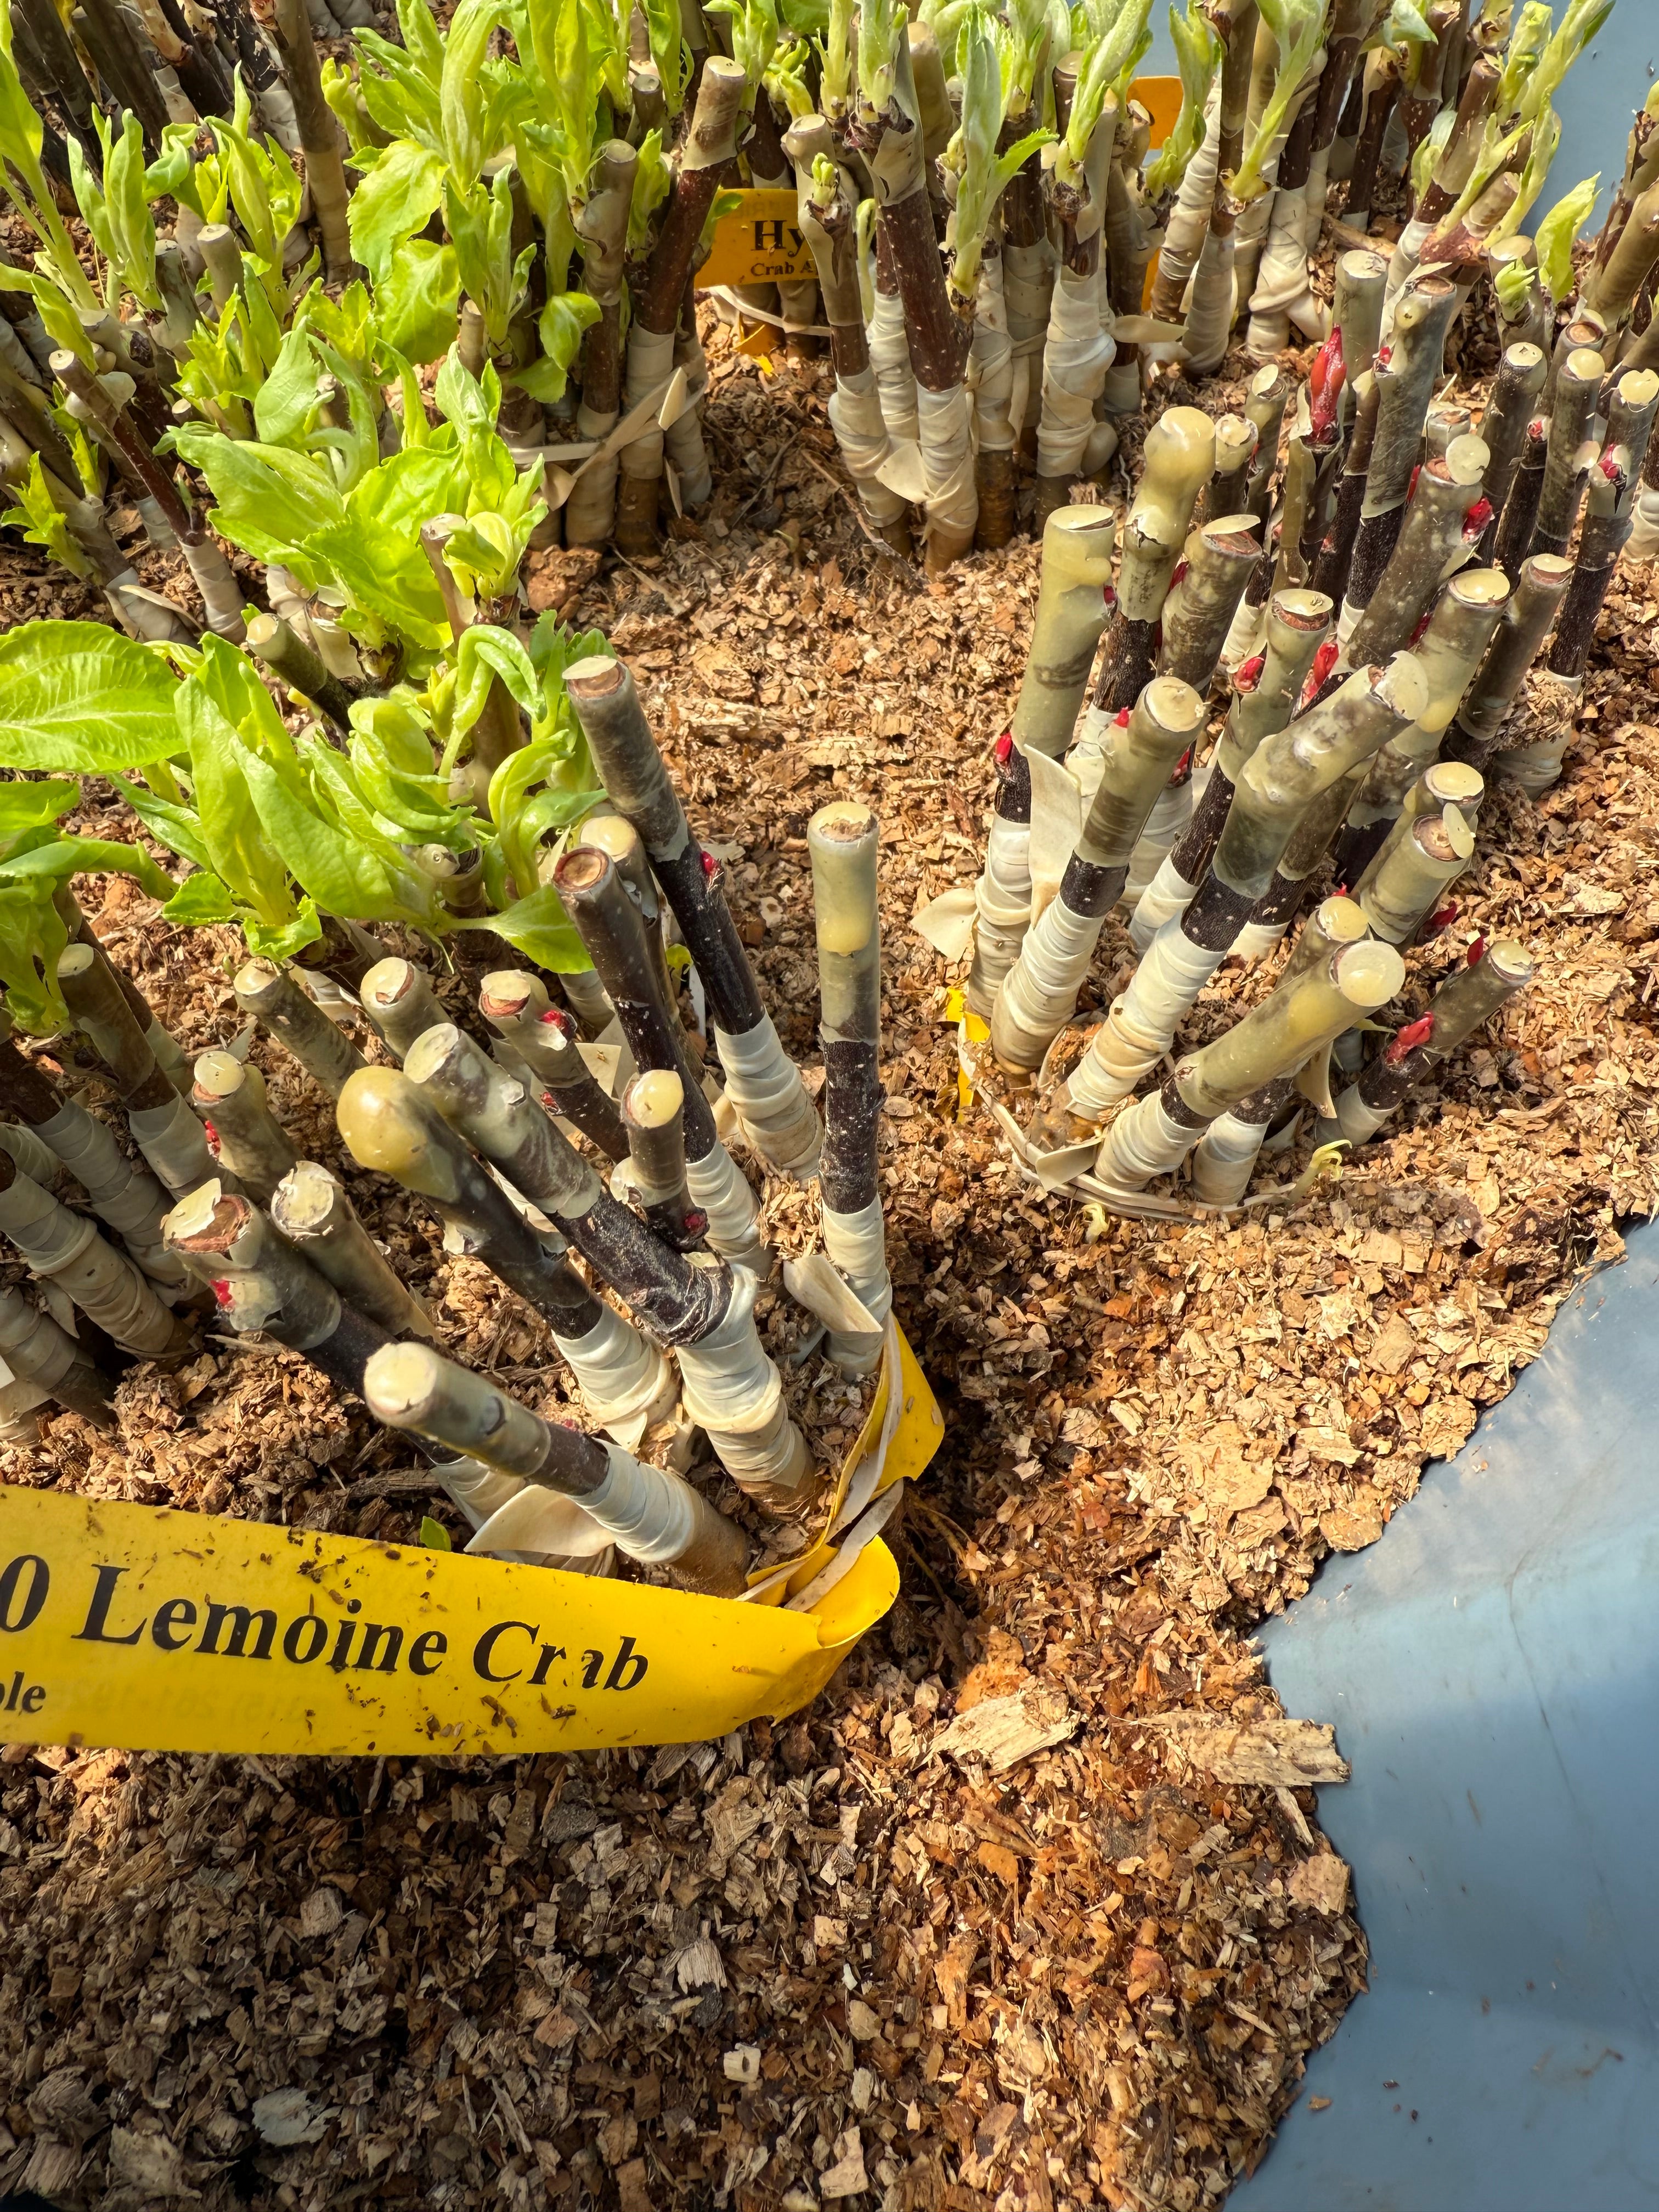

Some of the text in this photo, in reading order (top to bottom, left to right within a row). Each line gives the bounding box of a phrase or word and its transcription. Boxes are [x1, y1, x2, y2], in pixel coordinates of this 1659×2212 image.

[751, 221, 804, 257] Hy
[751, 262, 794, 276] Crab
[0, 1554, 648, 1691] 0 Lemoine Crab
